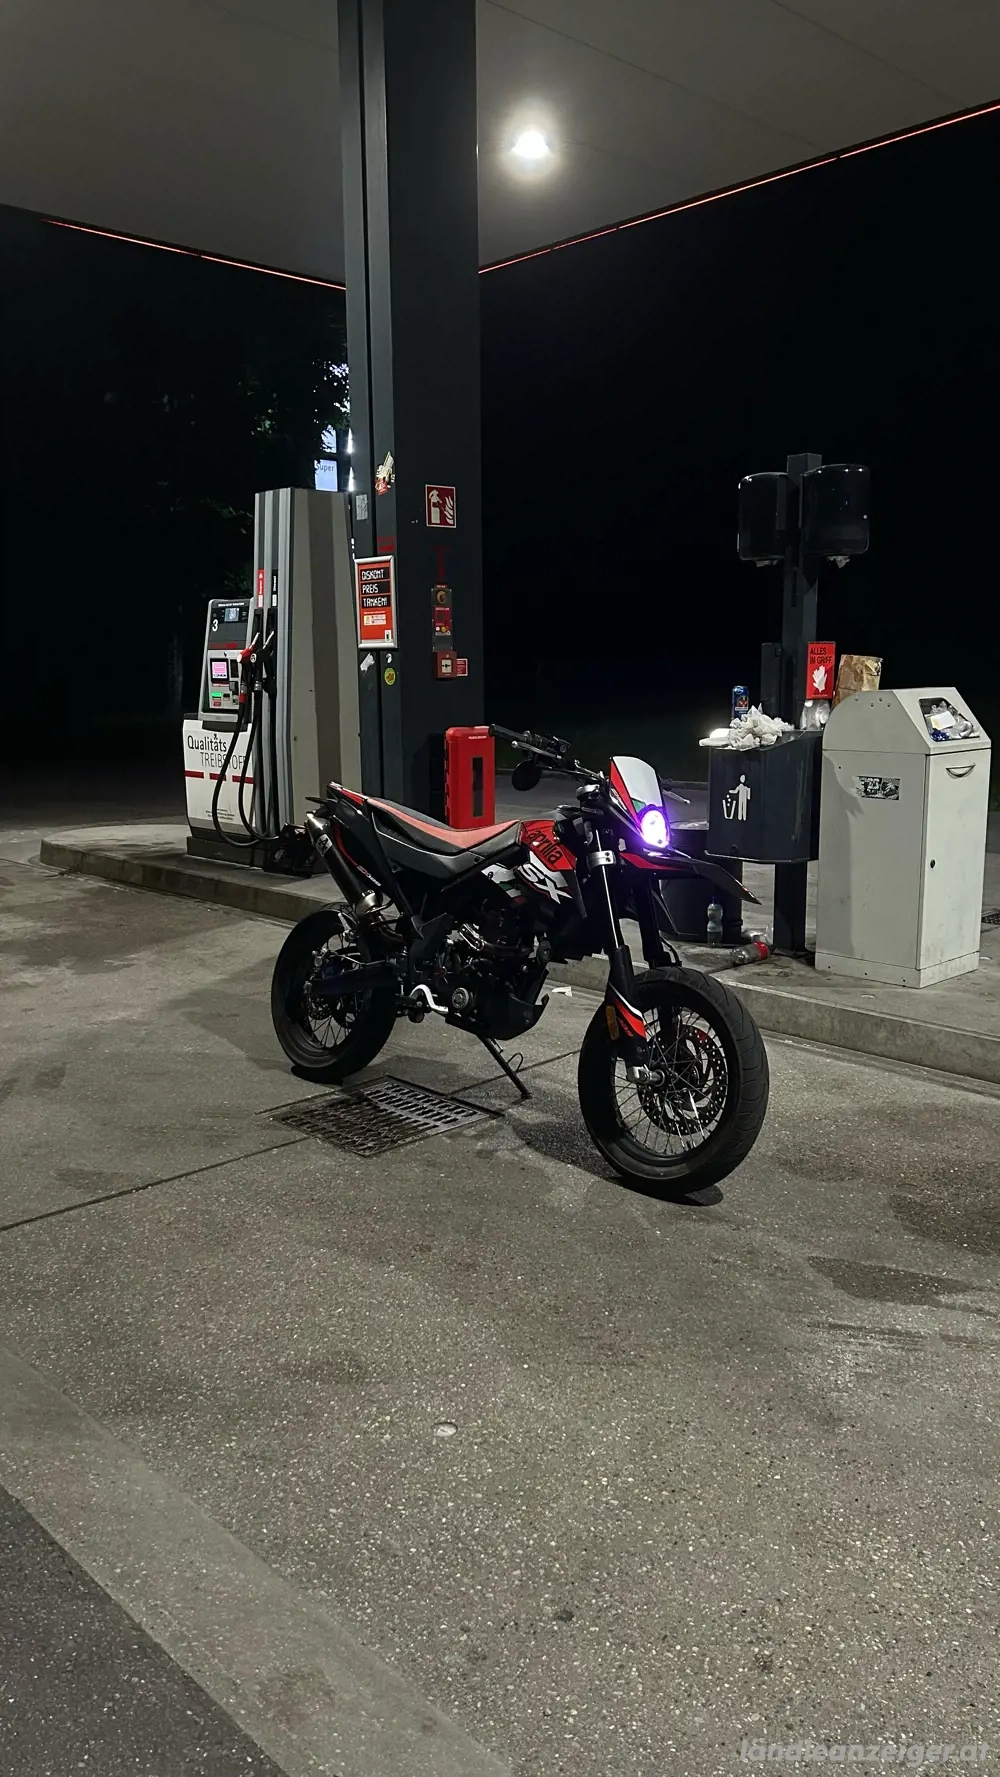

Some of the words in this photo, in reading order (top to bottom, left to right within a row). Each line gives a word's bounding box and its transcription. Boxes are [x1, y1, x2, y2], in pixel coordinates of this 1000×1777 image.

[316, 463, 335, 472] Super
[361, 569, 385, 581] DISKONT
[362, 583, 379, 594] PREIS
[363, 596, 388, 608] TANKEN!
[212, 619, 219, 631] 3
[810, 648, 826, 656] ALLES
[817, 656, 832, 664] GRIFF
[187, 735, 227, 752] Qualitäts
[527, 829, 563, 865] aprilia
[517, 862, 573, 905] SX
